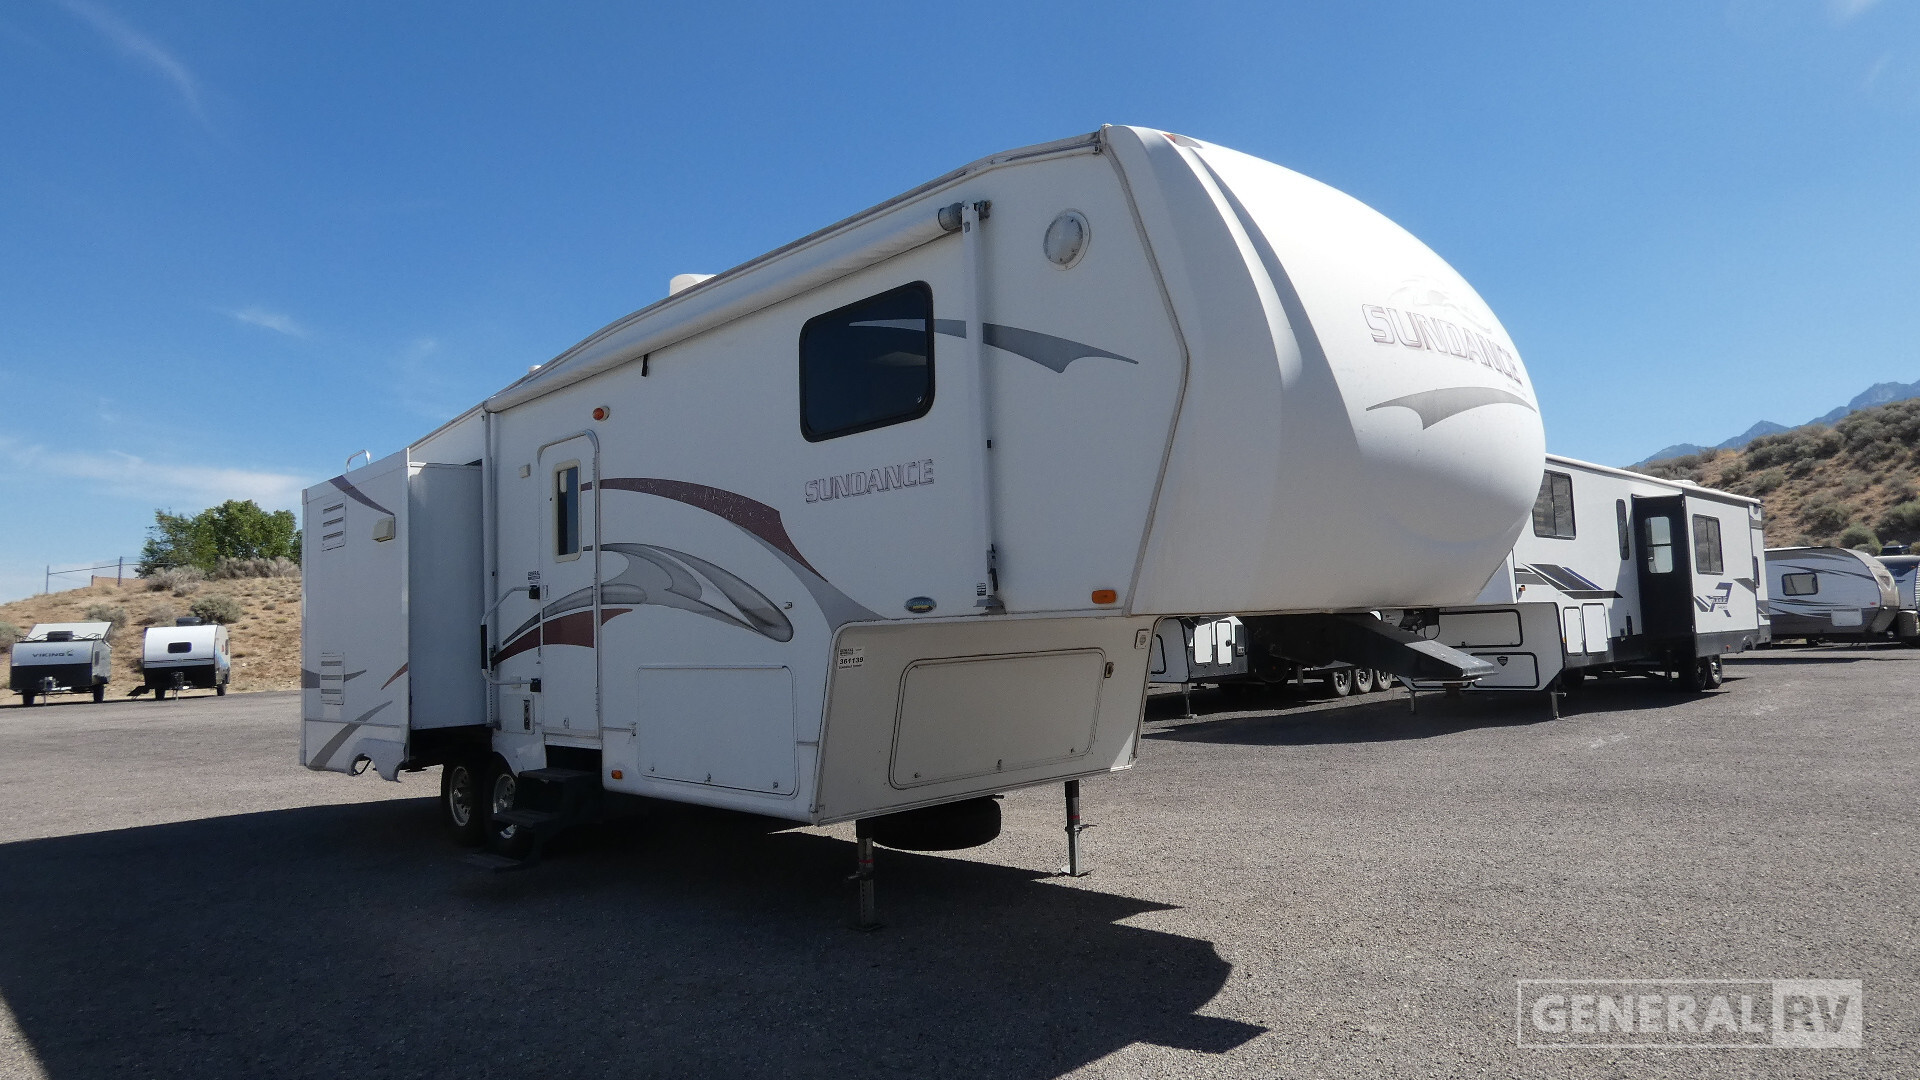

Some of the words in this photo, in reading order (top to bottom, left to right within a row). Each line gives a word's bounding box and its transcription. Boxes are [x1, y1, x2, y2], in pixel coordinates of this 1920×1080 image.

[1362, 303, 1523, 386] SUNDANCE
[805, 458, 934, 504] SUNDANCE
[839, 657, 864, 665] 361139
